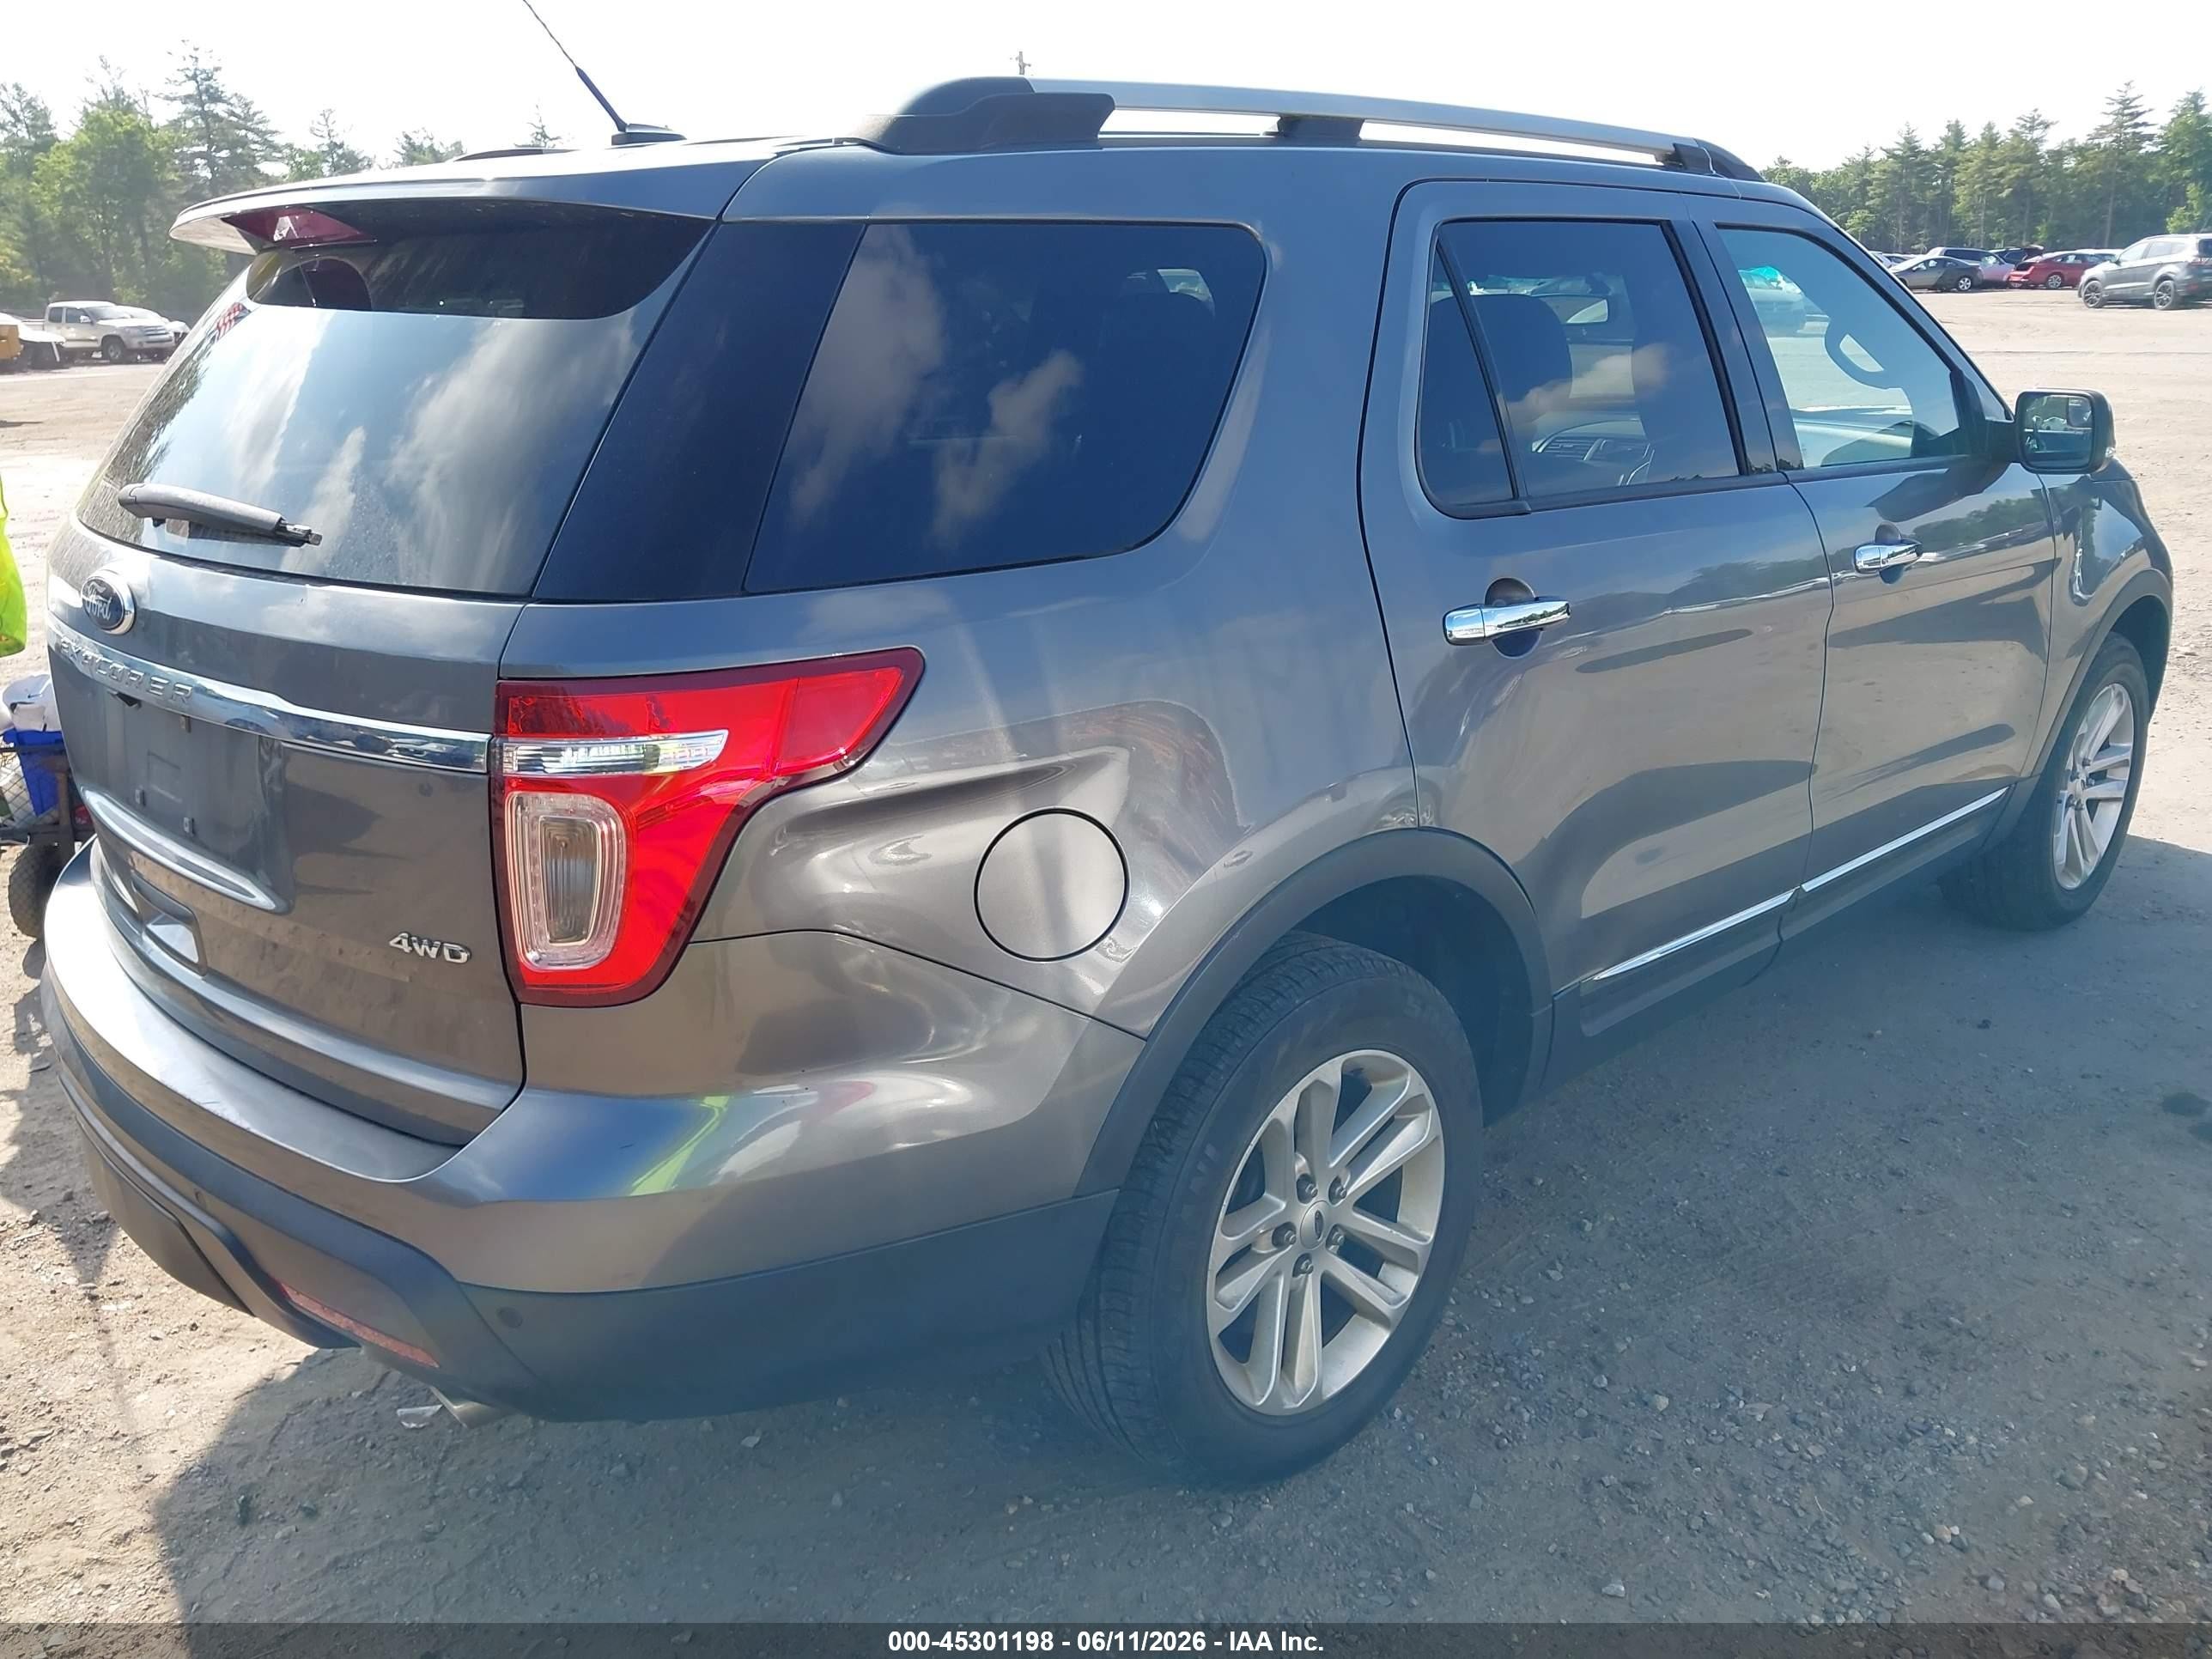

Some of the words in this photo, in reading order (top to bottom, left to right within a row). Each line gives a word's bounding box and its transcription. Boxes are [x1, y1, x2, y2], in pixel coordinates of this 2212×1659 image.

[82, 580, 112, 621] Ford
[59, 636, 193, 704] EXPLORER
[389, 933, 471, 963] 4WD
